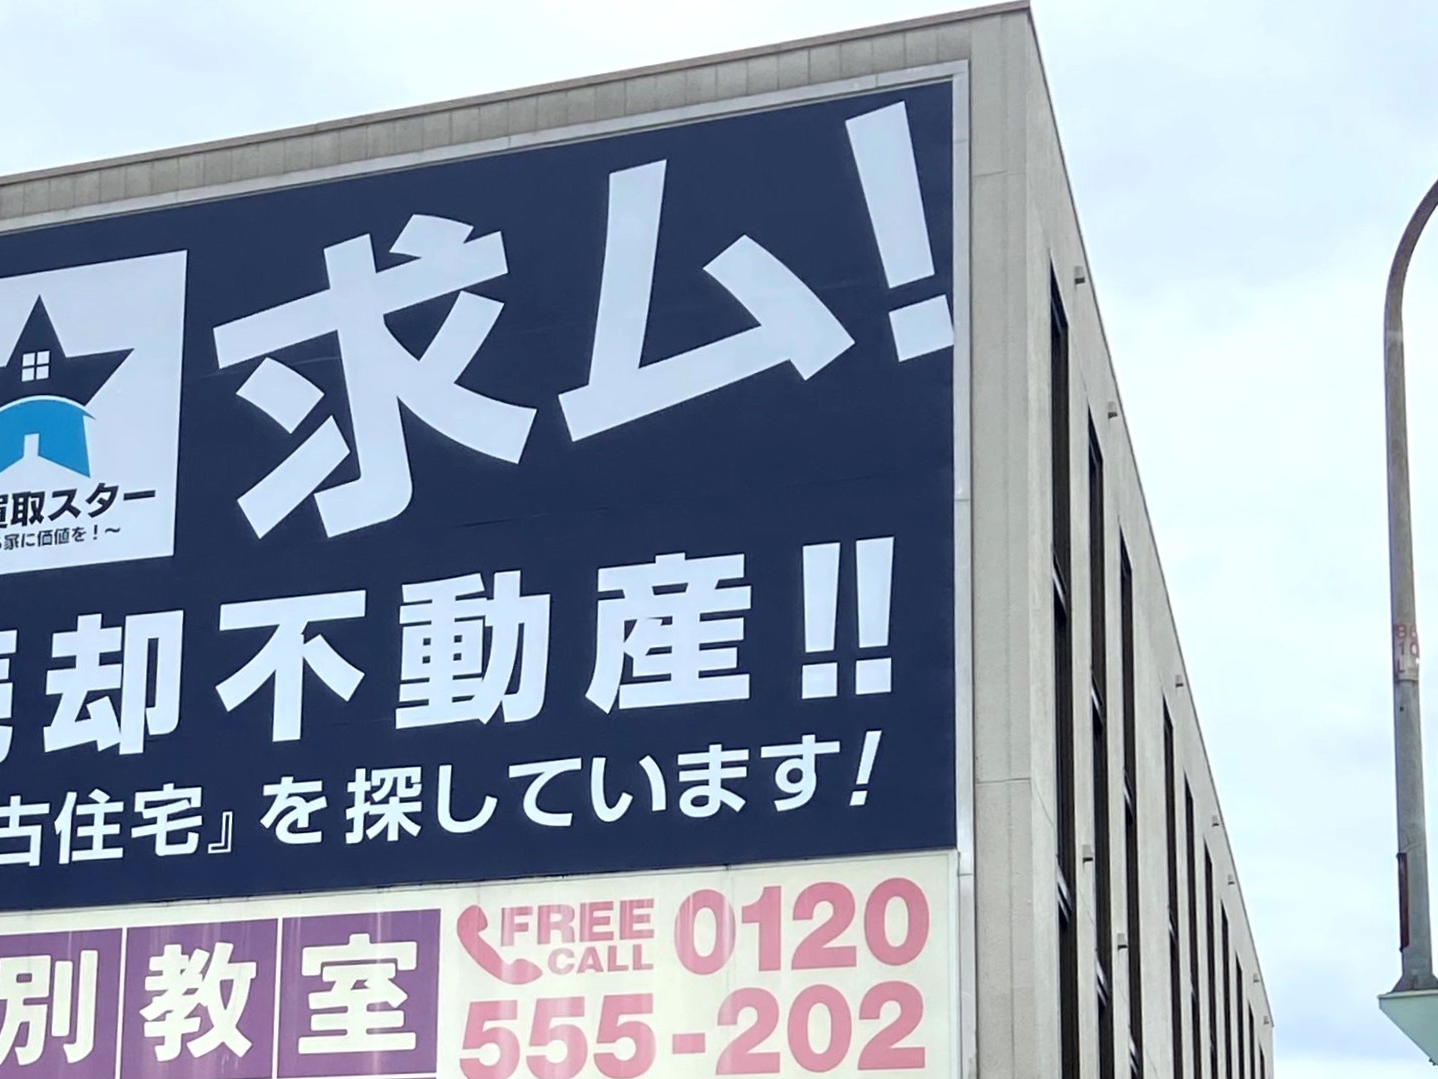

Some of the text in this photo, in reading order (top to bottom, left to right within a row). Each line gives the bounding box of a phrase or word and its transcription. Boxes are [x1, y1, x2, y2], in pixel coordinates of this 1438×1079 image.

[213, 100, 955, 539] 求ム!
[500, 898, 655, 947] FREE
[548, 943, 654, 976] CALL
[674, 877, 930, 976] 0120
